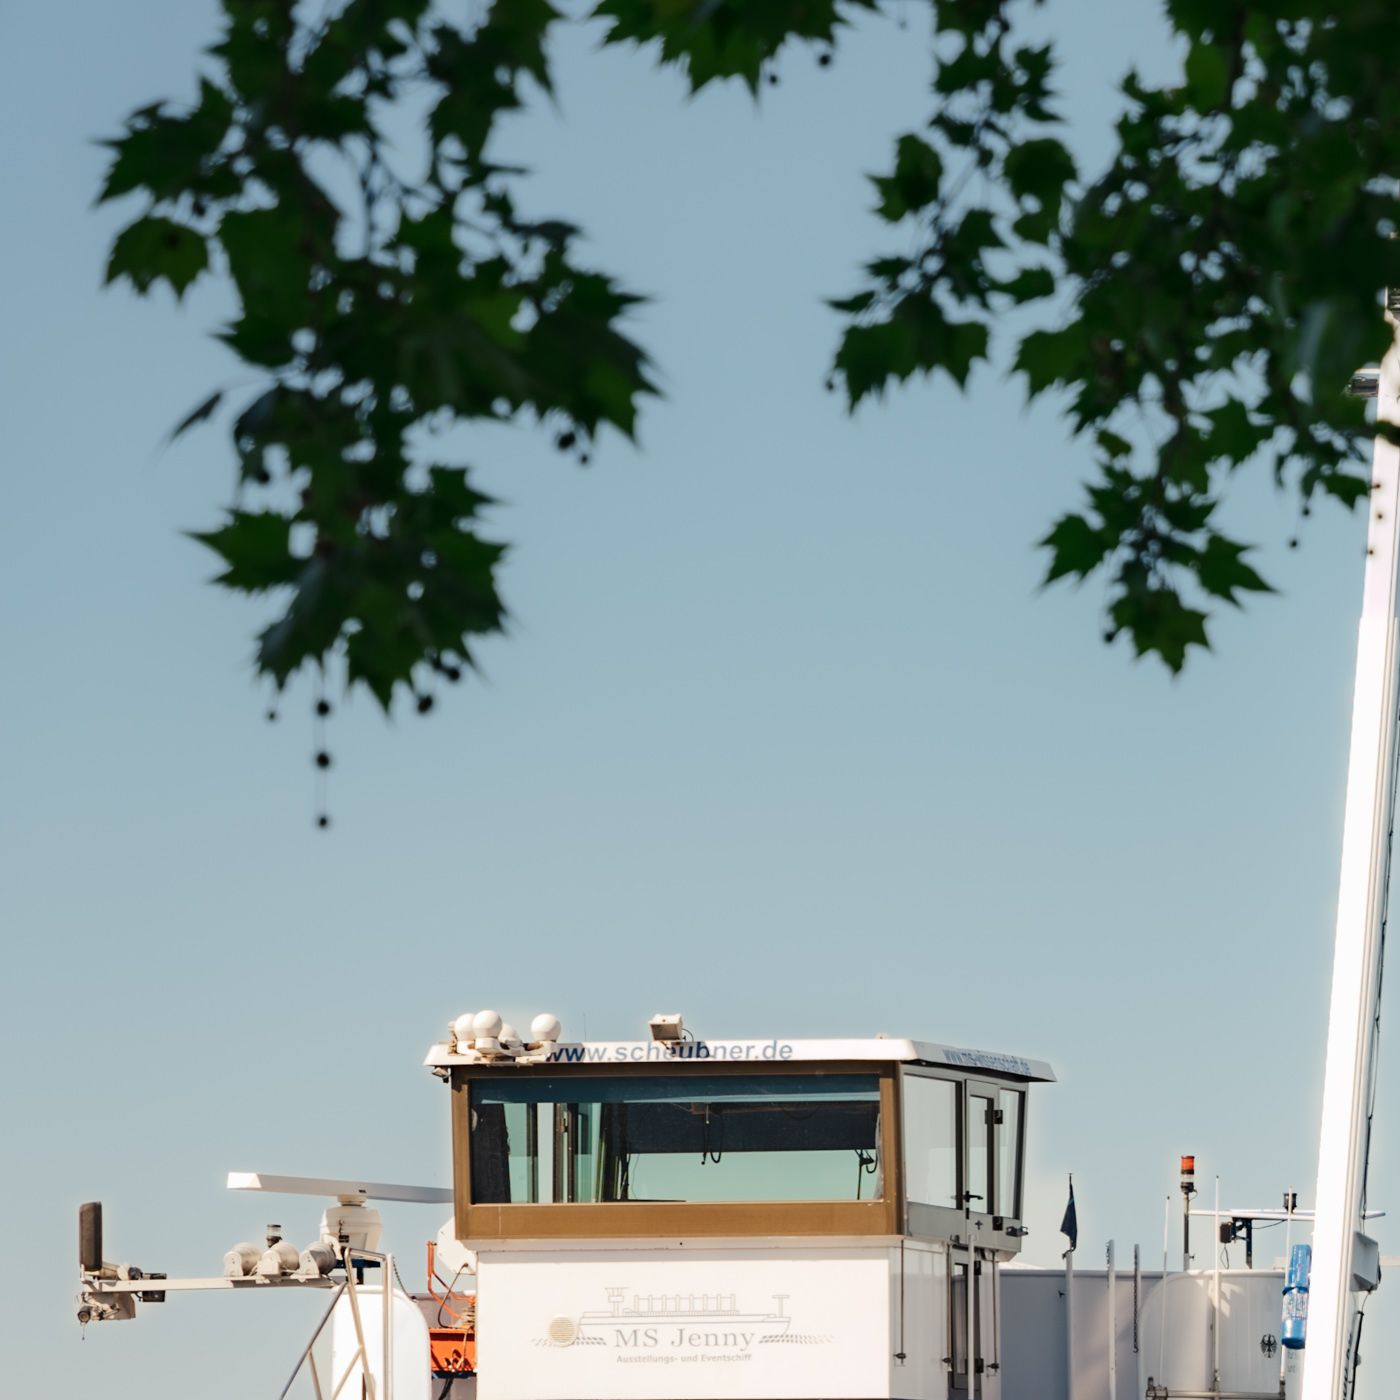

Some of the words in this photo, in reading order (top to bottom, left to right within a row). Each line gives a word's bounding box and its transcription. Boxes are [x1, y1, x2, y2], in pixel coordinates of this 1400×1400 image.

[614, 1328, 659, 1347] MS
[671, 1328, 756, 1351] Jenny
[616, 1354, 677, 1364] Ausstellungs-
[681, 1354, 698, 1362] und
[701, 1353, 752, 1362] Eventschiff
